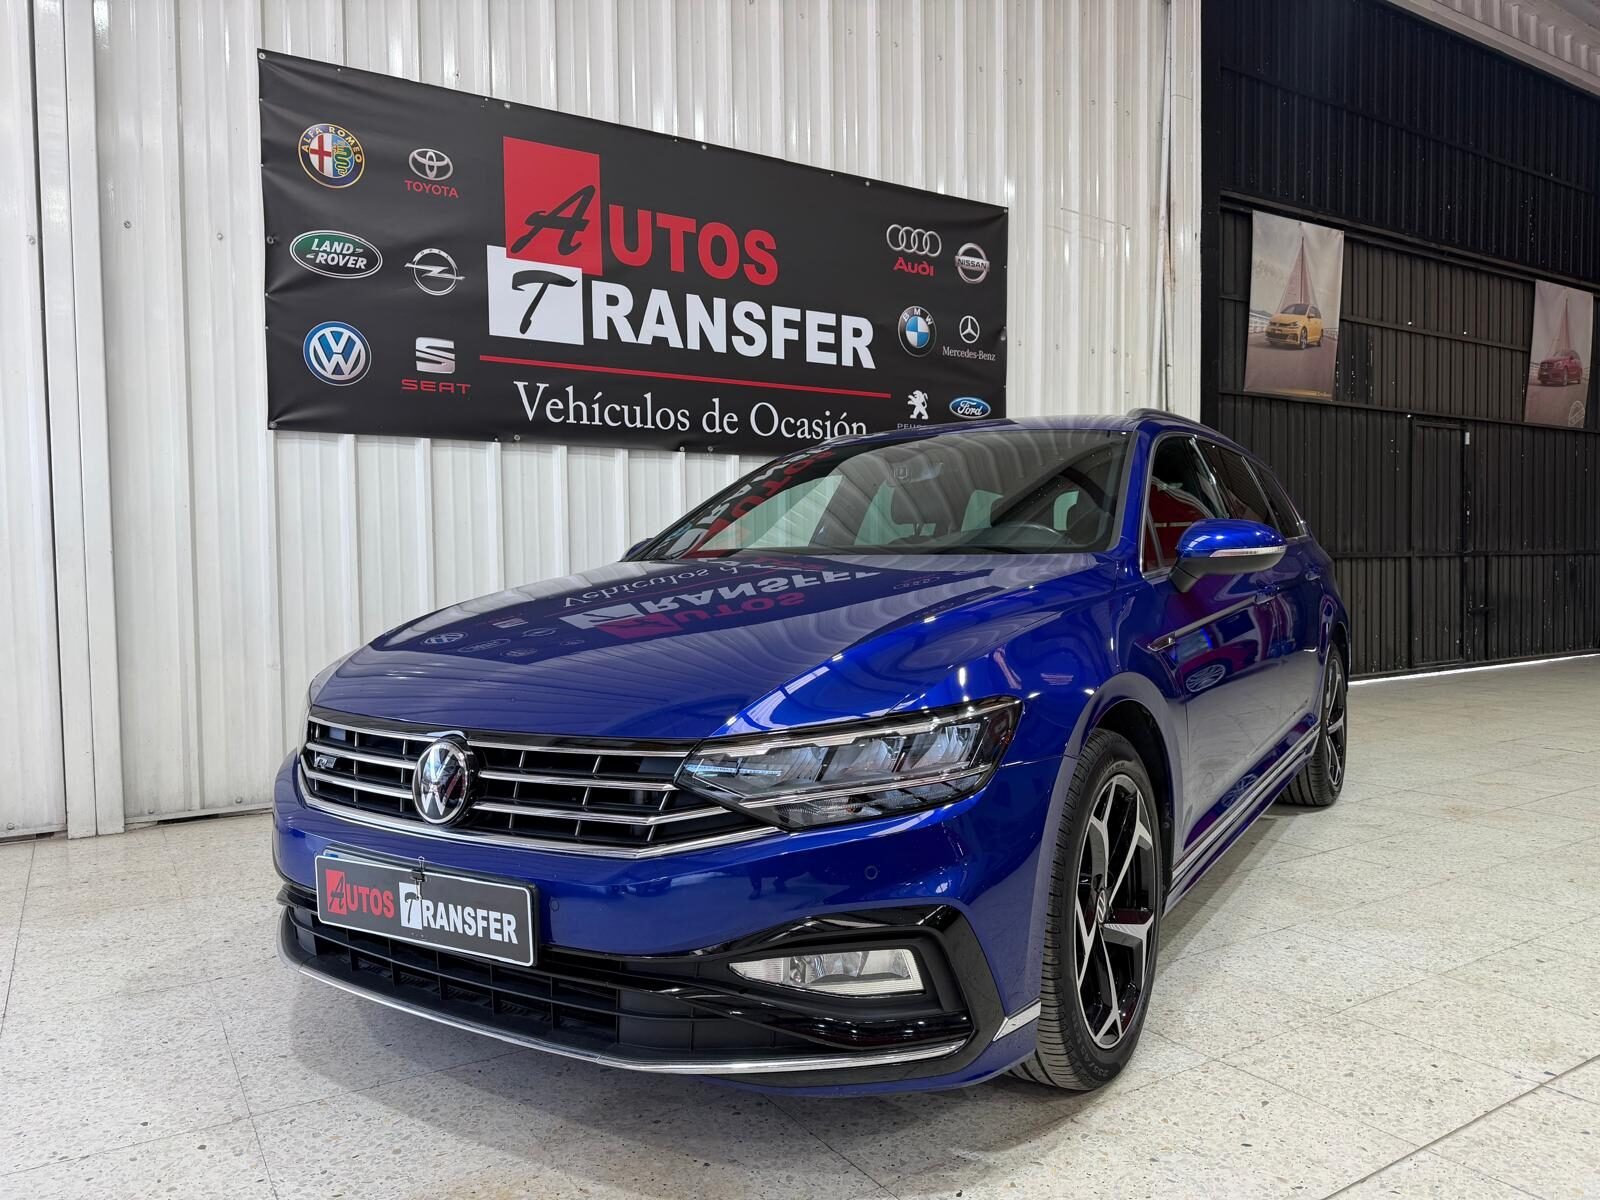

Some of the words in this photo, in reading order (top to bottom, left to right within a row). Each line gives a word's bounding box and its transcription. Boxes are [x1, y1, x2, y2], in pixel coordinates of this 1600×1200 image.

[302, 127, 324, 153] ALFA
[329, 126, 362, 163] ROMEO
[405, 180, 459, 198] TOYOTA
[510, 184, 779, 286] AUTOS
[311, 238, 354, 255] LAND
[315, 252, 367, 270] ROVER
[893, 256, 935, 277] Audi
[957, 258, 988, 270] NISSAN
[511, 269, 876, 370] TRANSFER
[902, 307, 933, 326] BMW
[942, 345, 996, 361] Mercedes-Benz
[401, 379, 472, 395] SEAT
[513, 381, 690, 432] Vehículos
[702, 398, 739, 435] de
[750, 401, 868, 441] Ocasión
[957, 400, 983, 416] Ford
[328, 873, 395, 918] AUTOS
[404, 892, 519, 944] TRANSFER
